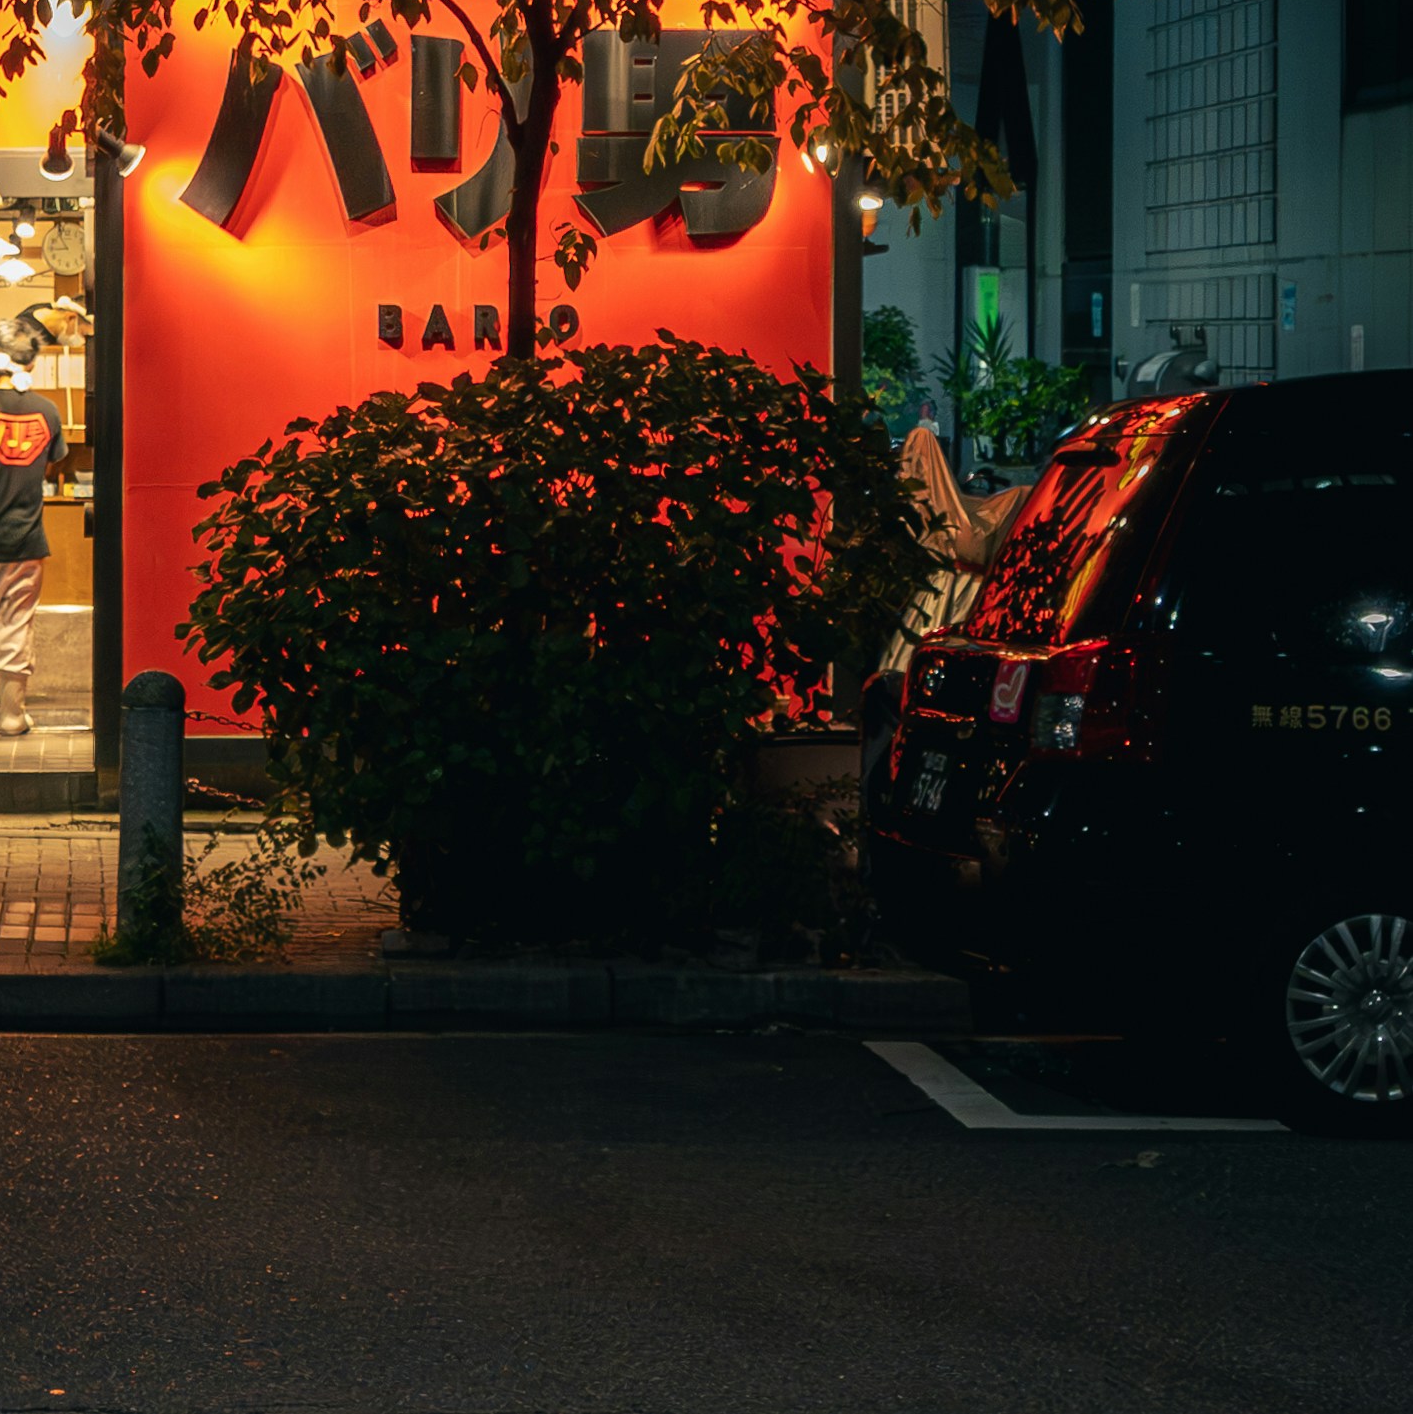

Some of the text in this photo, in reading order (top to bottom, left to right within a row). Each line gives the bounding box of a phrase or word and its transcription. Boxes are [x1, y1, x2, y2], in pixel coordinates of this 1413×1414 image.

[179, 20, 781, 239] バリ男
[378, 304, 579, 350] BARO
